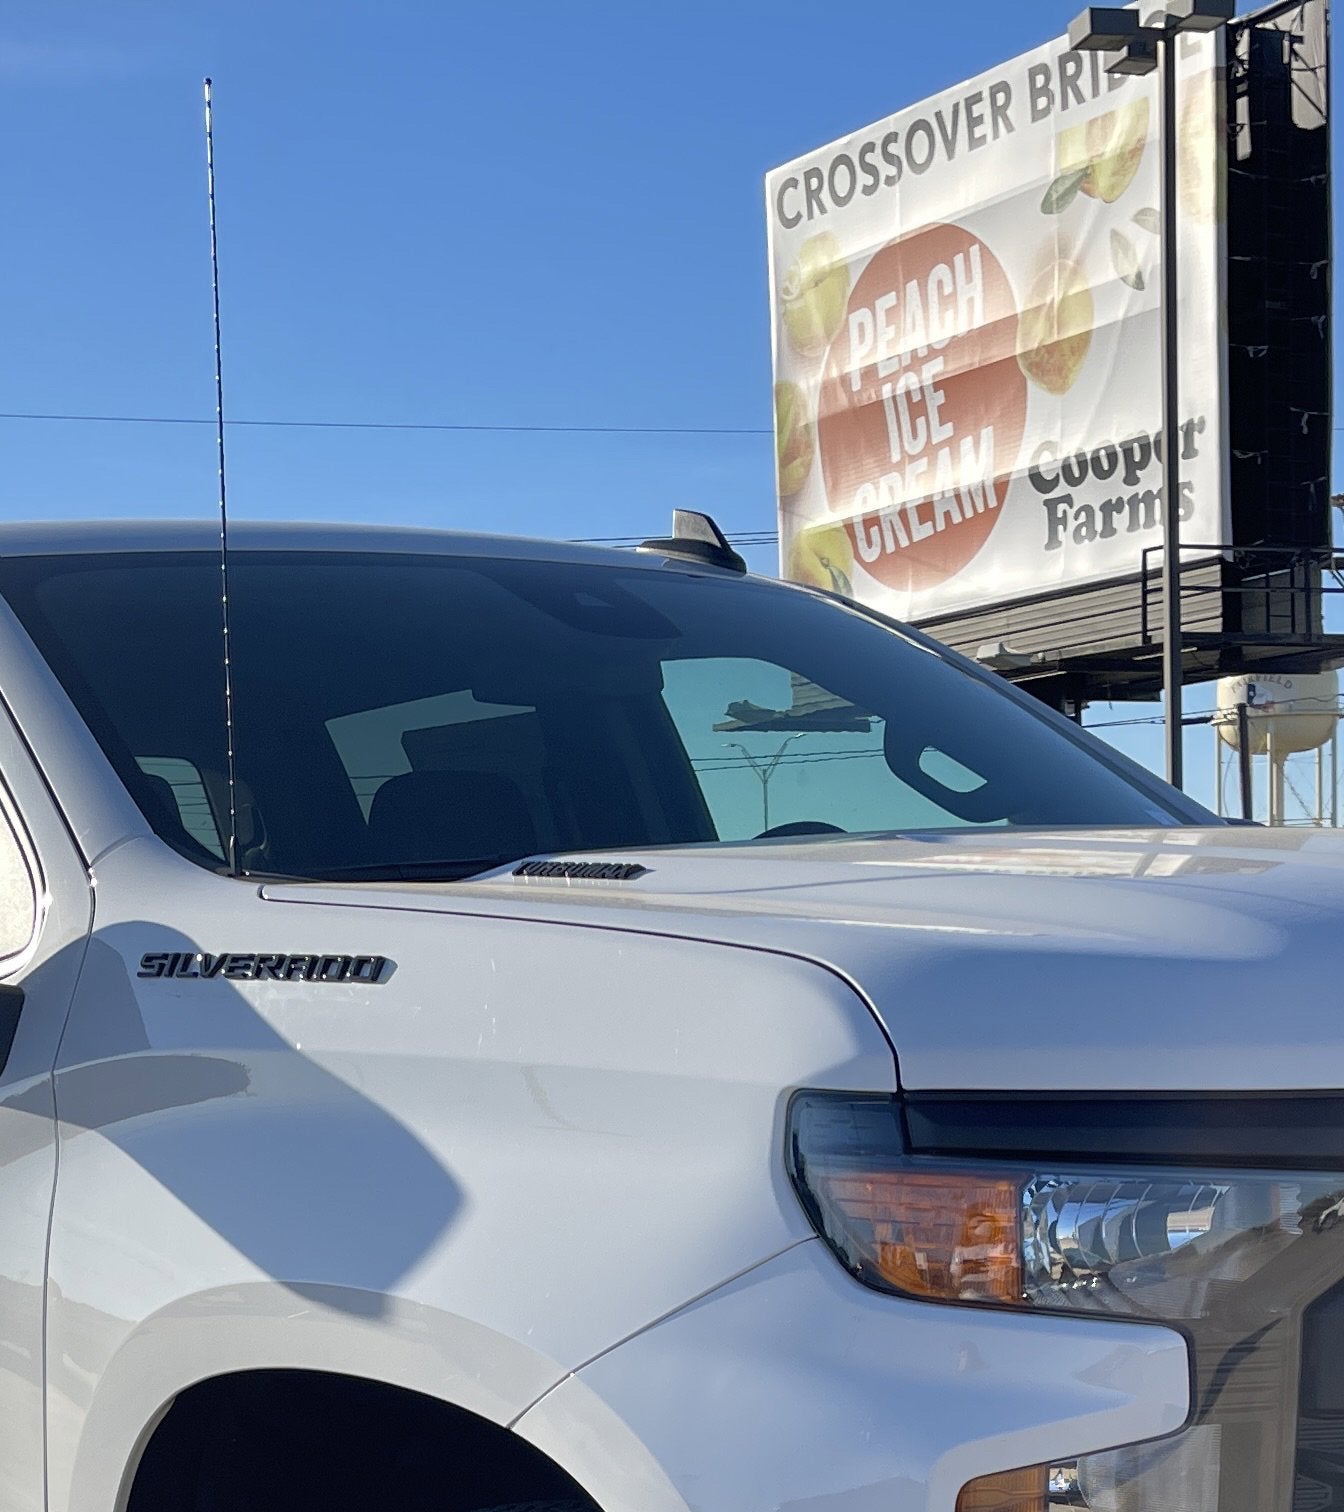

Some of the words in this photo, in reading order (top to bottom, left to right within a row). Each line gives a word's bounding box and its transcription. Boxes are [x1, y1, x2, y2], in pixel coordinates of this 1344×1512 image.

[775, 79, 1016, 230] CROSSOVER
[847, 243, 986, 392] PEACH
[881, 355, 954, 464] ICE
[852, 425, 999, 564] CREAM
[136, 952, 391, 984] SILVERADO
